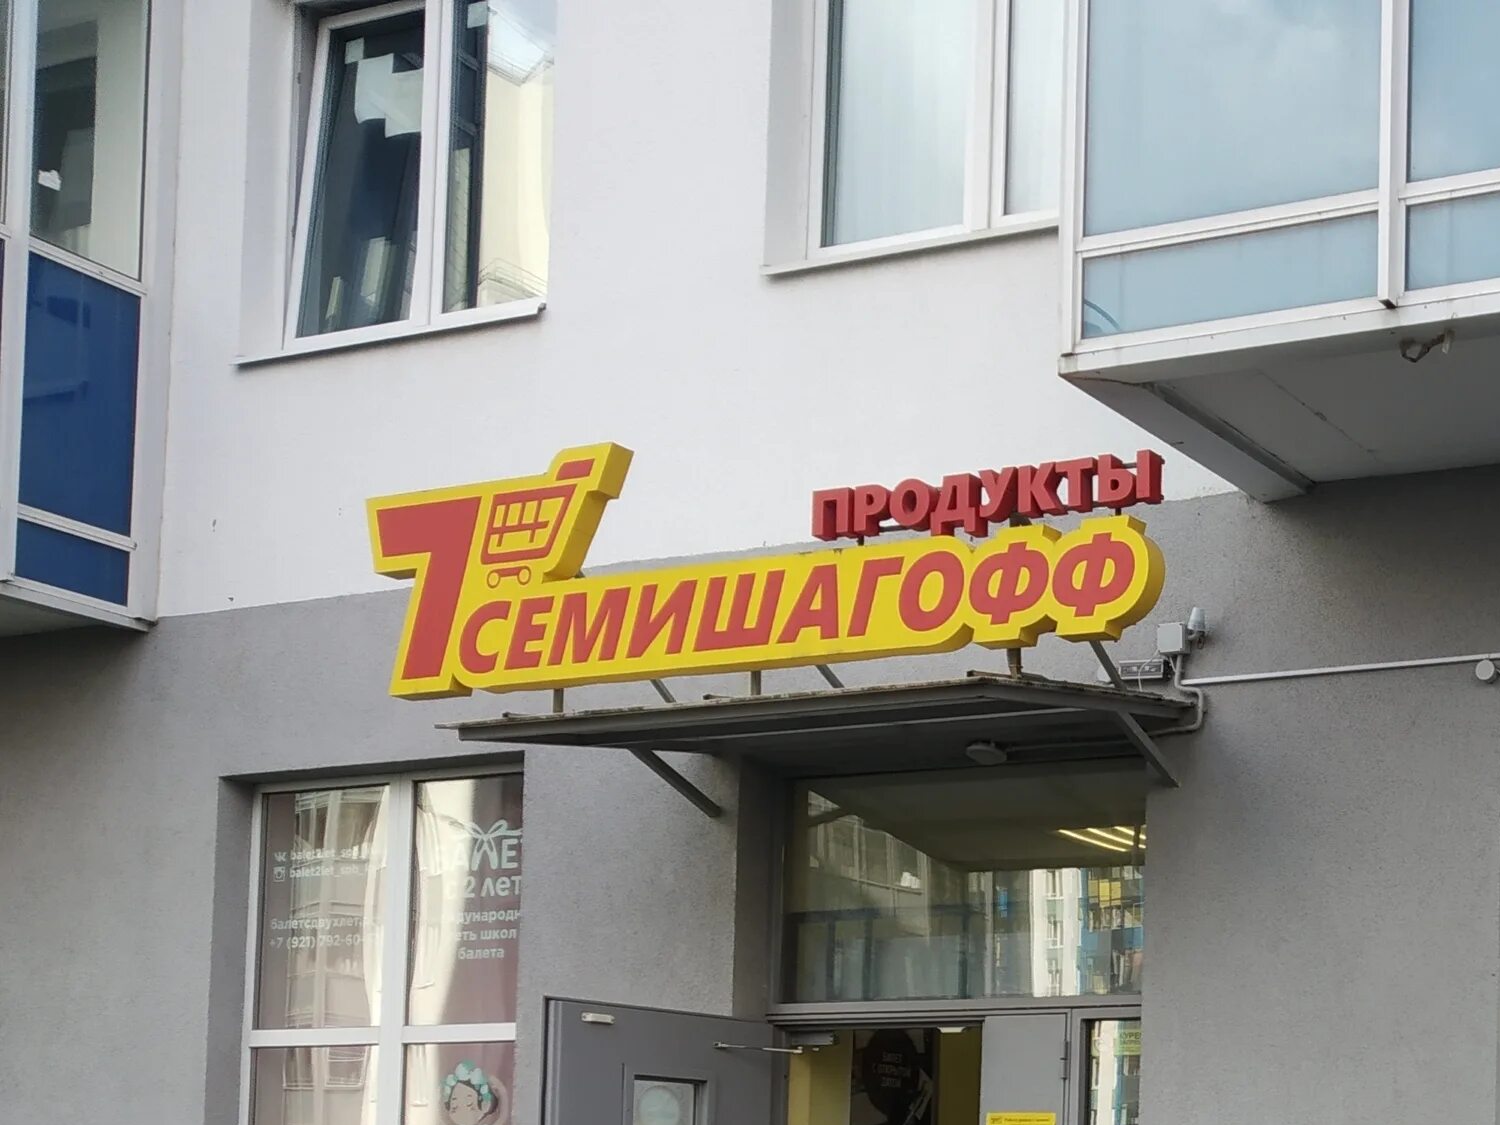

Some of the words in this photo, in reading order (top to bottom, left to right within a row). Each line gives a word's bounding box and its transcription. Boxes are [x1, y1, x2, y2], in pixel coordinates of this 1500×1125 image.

[811, 449, 1165, 541] ПРОДУКТЫ
[457, 530, 1136, 675] СЕМИШАГОФФ
[458, 946, 505, 960] балета
